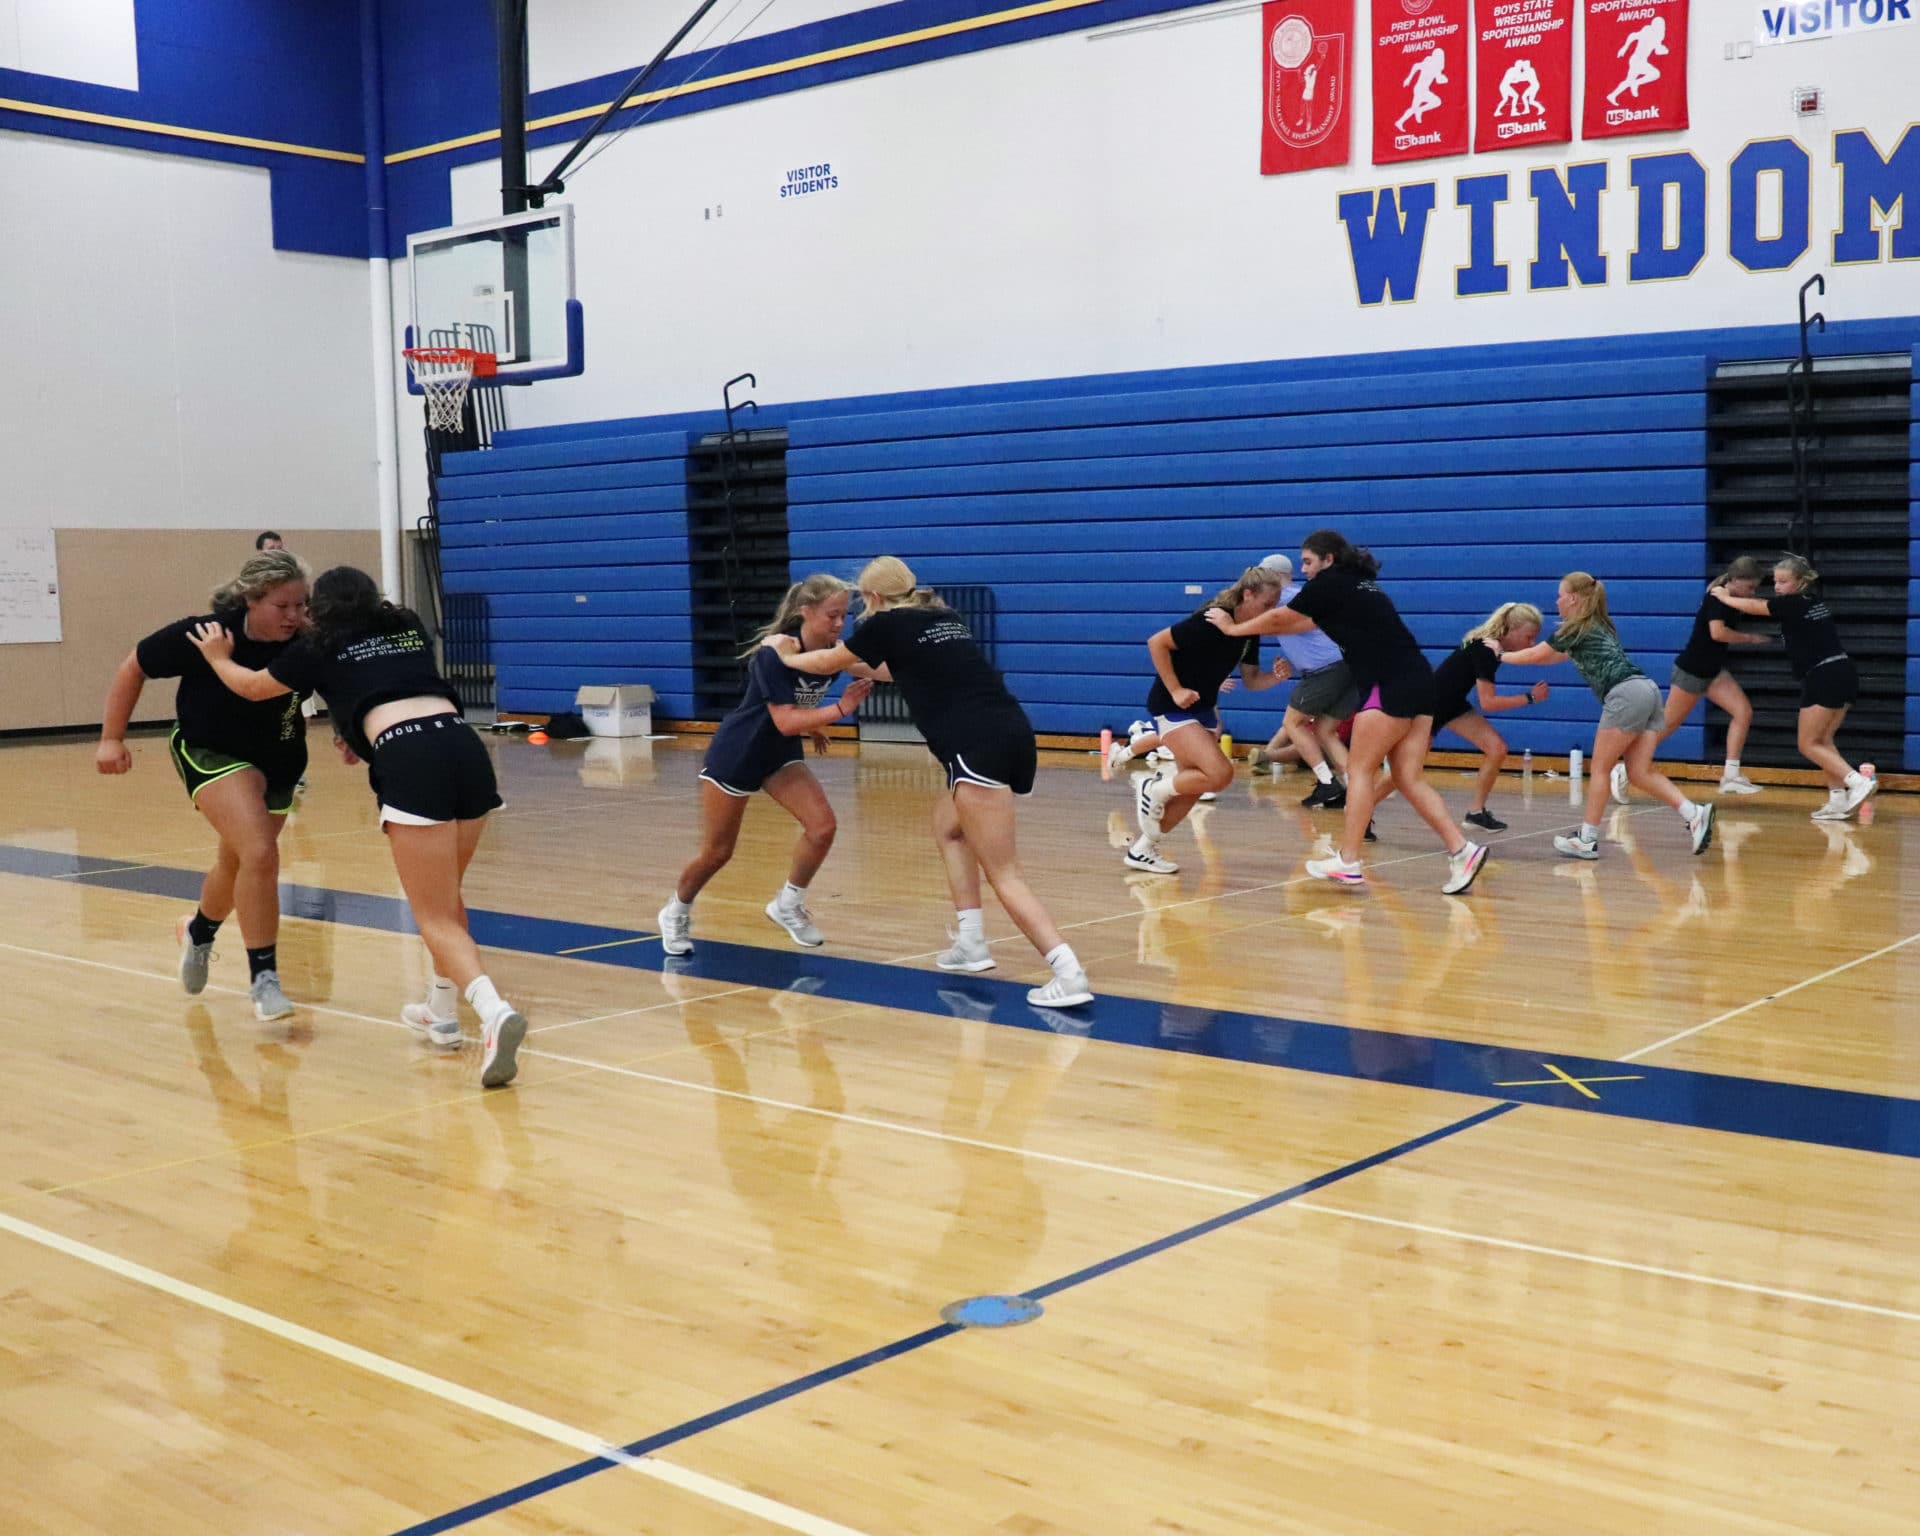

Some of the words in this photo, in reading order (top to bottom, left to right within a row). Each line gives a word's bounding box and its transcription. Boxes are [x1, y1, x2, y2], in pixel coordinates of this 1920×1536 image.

[1493, 3, 1521, 16] BOYS
[1522, 0, 1554, 12] STATE
[1616, 8, 1655, 22] AWARD
[1391, 19, 1416, 32] PREP
[1418, 14, 1446, 28] BOWL
[1495, 9, 1552, 27] WRESTLING
[1762, 0, 1911, 38] VISITOR
[1379, 24, 1459, 46] SPORTSMANSHIP
[1482, 18, 1564, 41] SPORTSMANSHIP
[1402, 40, 1435, 54] AWARD
[1504, 34, 1542, 49] AWARD
[786, 163, 831, 183] VISITOR
[780, 176, 838, 198] STUDENTS
[1336, 121, 1920, 308] WINDOM
